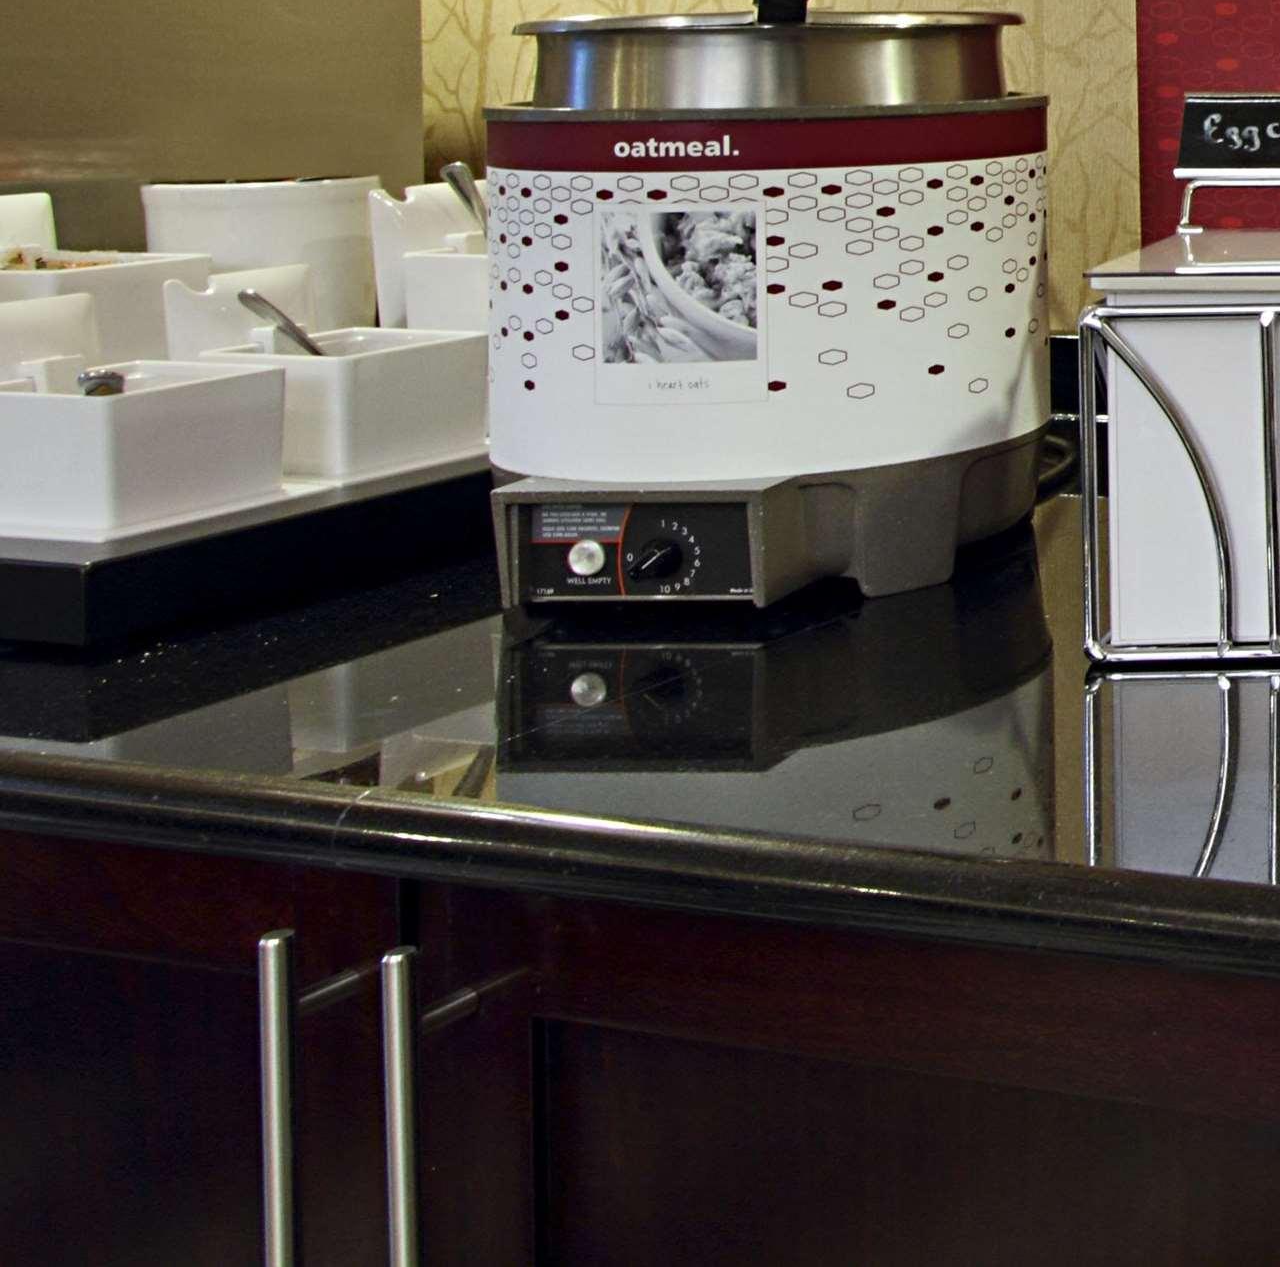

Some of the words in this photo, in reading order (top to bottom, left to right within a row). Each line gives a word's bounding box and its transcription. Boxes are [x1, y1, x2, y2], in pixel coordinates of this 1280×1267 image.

[613, 134, 740, 158] oatmeal.
[660, 519, 665, 528] 1
[671, 521, 679, 531] 2
[681, 526, 688, 536] 3
[688, 535, 695, 543] 4
[693, 546, 701, 555] 5
[626, 552, 634, 562] 0
[694, 559, 701, 567] 6
[689, 569, 696, 578] 7
[683, 577, 690, 586] 8
[659, 584, 671, 594] 10
[674, 582, 681, 591] 9
